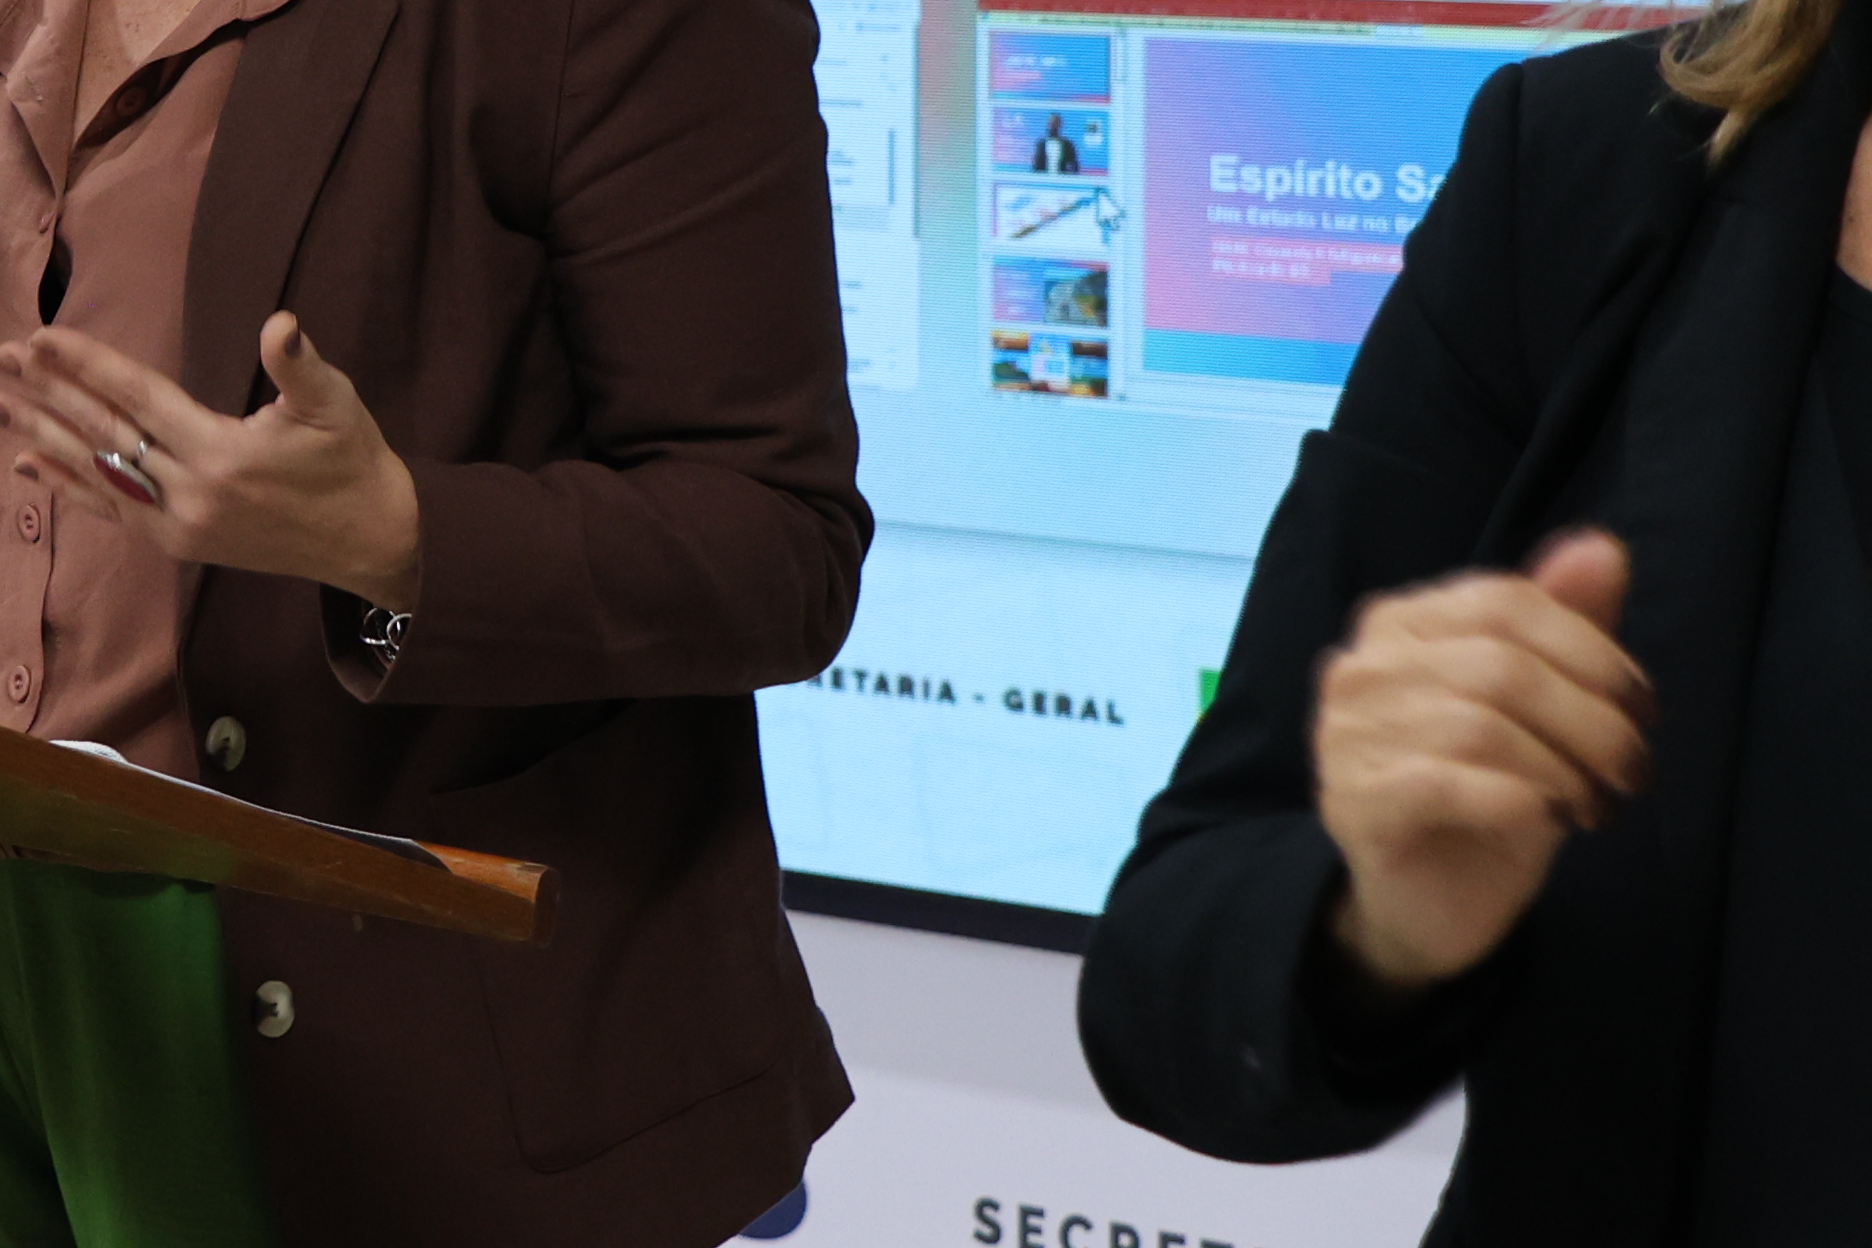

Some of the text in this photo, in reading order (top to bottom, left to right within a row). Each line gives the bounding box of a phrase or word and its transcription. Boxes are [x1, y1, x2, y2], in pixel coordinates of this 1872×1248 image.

[1209, 153, 1383, 203] Espírito
[1002, 685, 1125, 726] GERAL
[972, 1196, 1236, 1248] SECR
